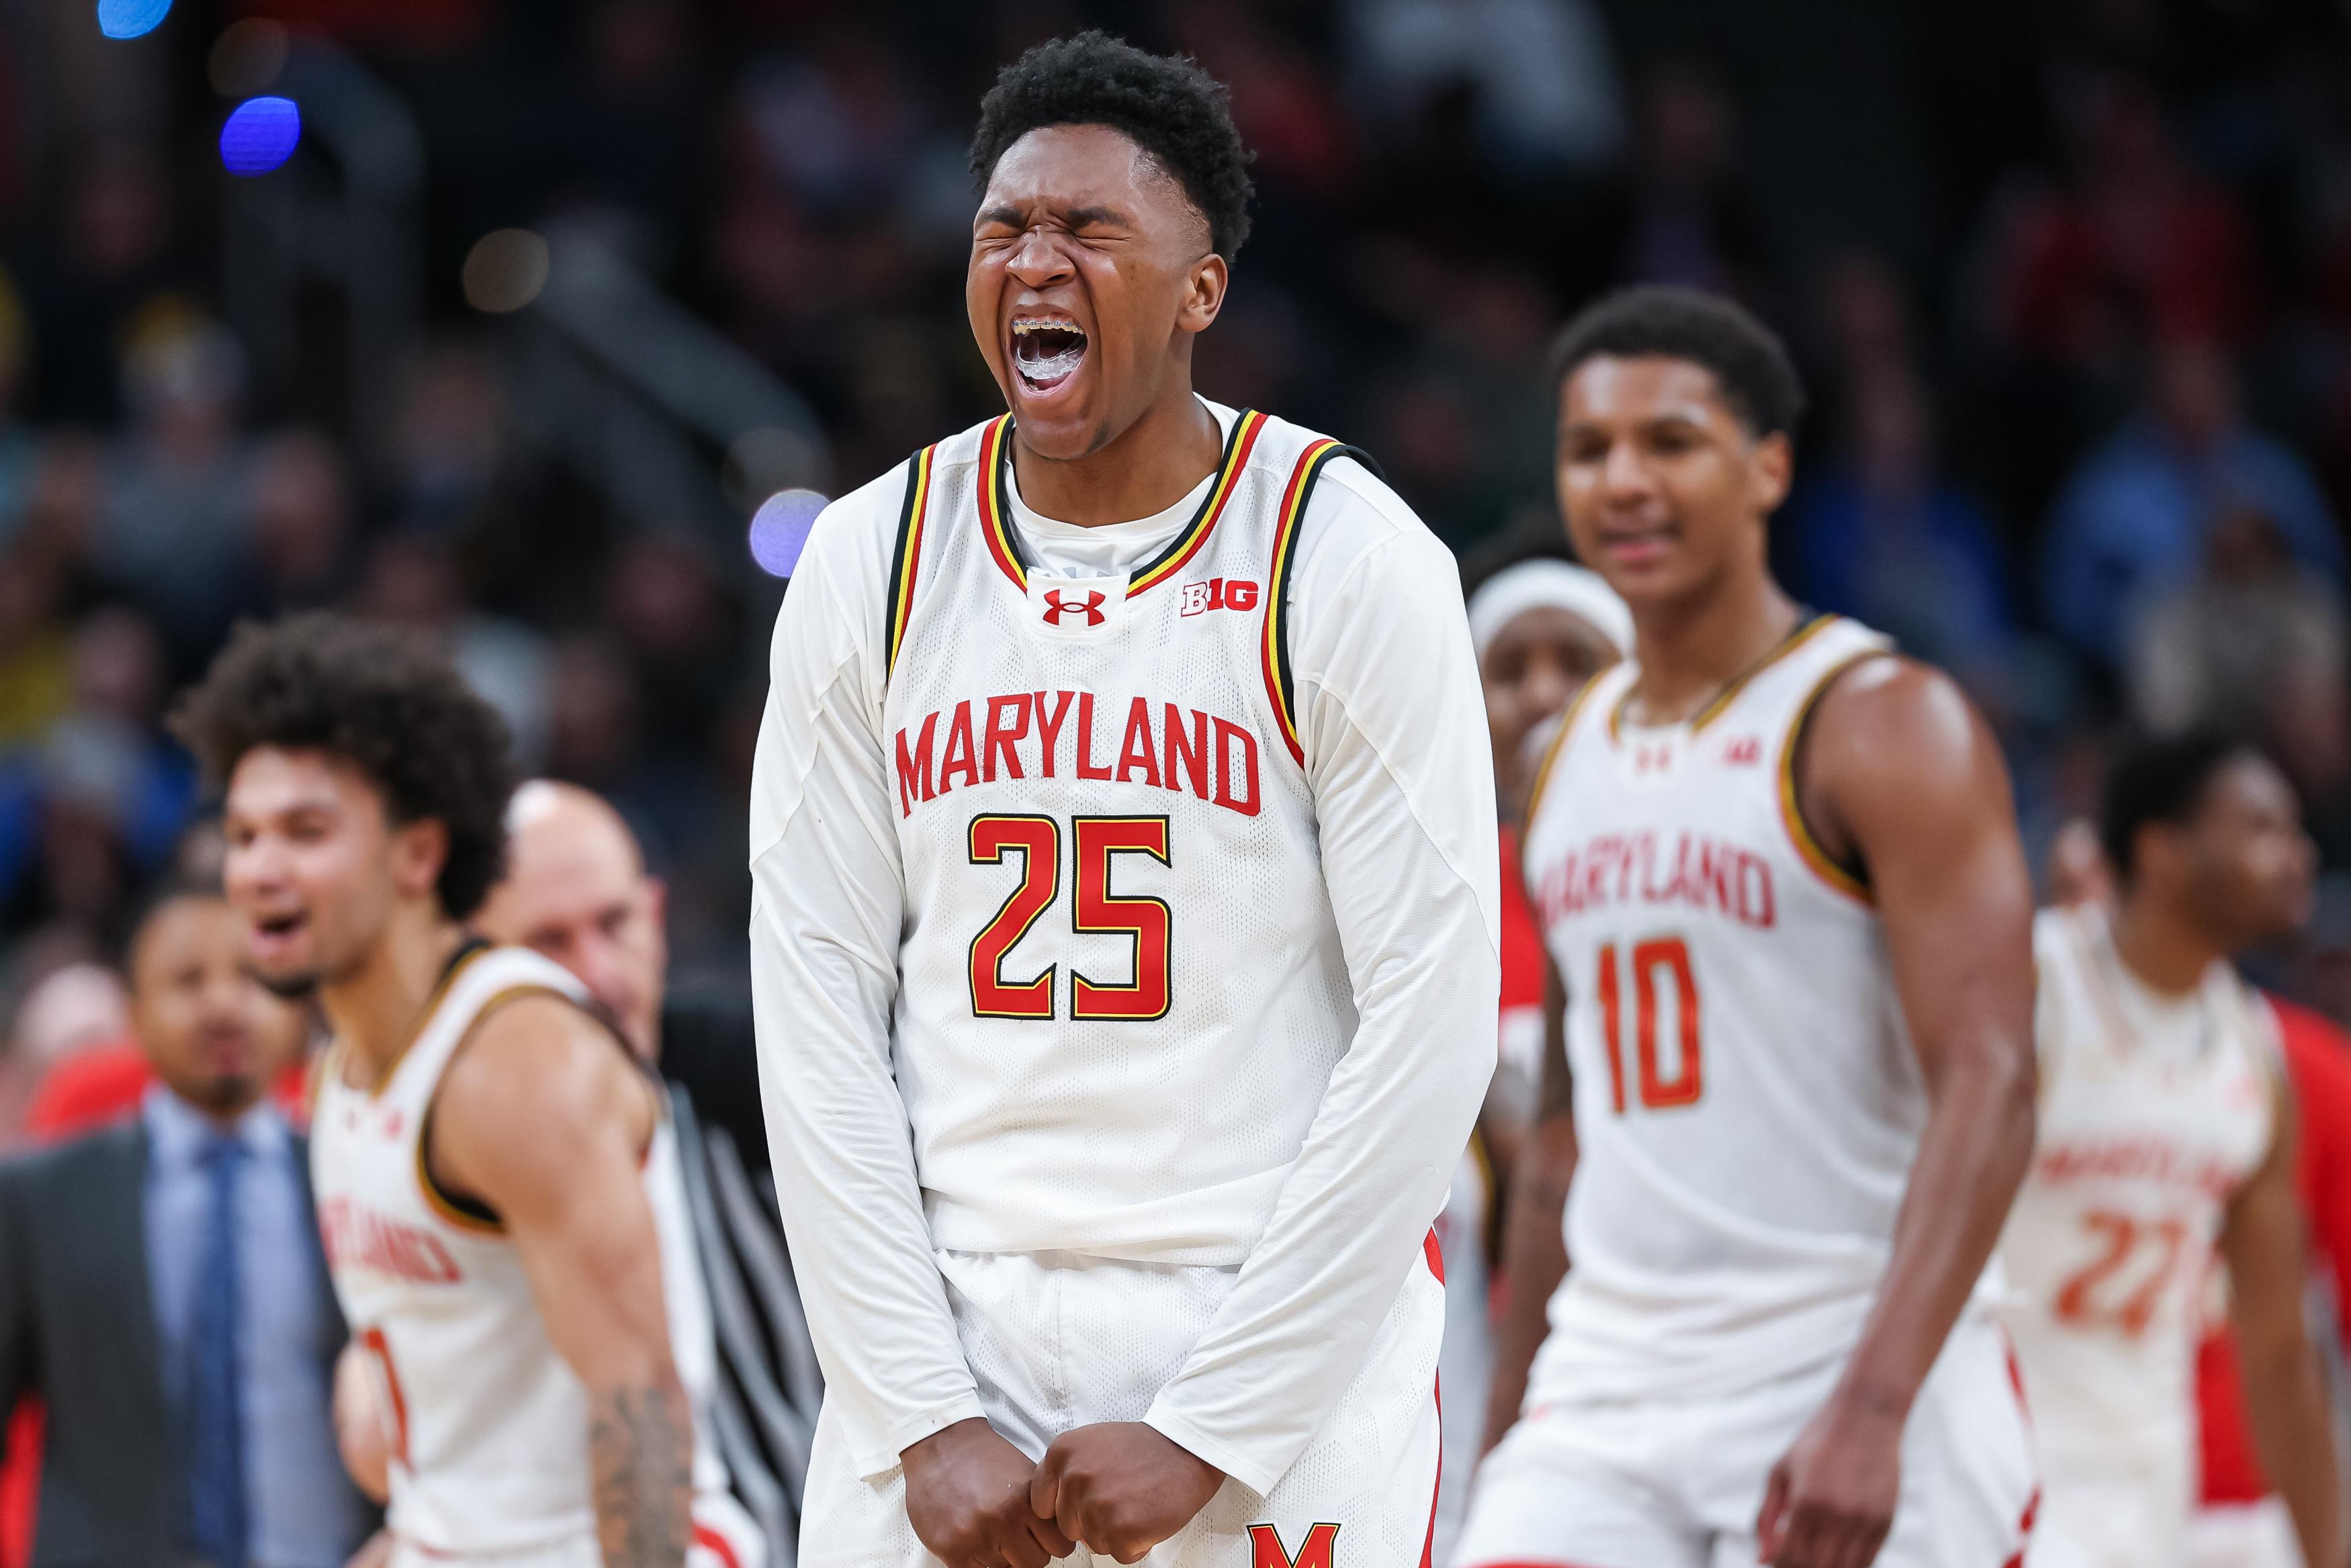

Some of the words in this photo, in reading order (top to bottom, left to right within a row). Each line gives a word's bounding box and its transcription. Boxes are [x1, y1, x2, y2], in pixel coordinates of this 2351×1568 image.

[895, 690, 1261, 819] MARYLAND
[968, 813, 1172, 1021] 25
[1596, 933, 1703, 1116] 10
